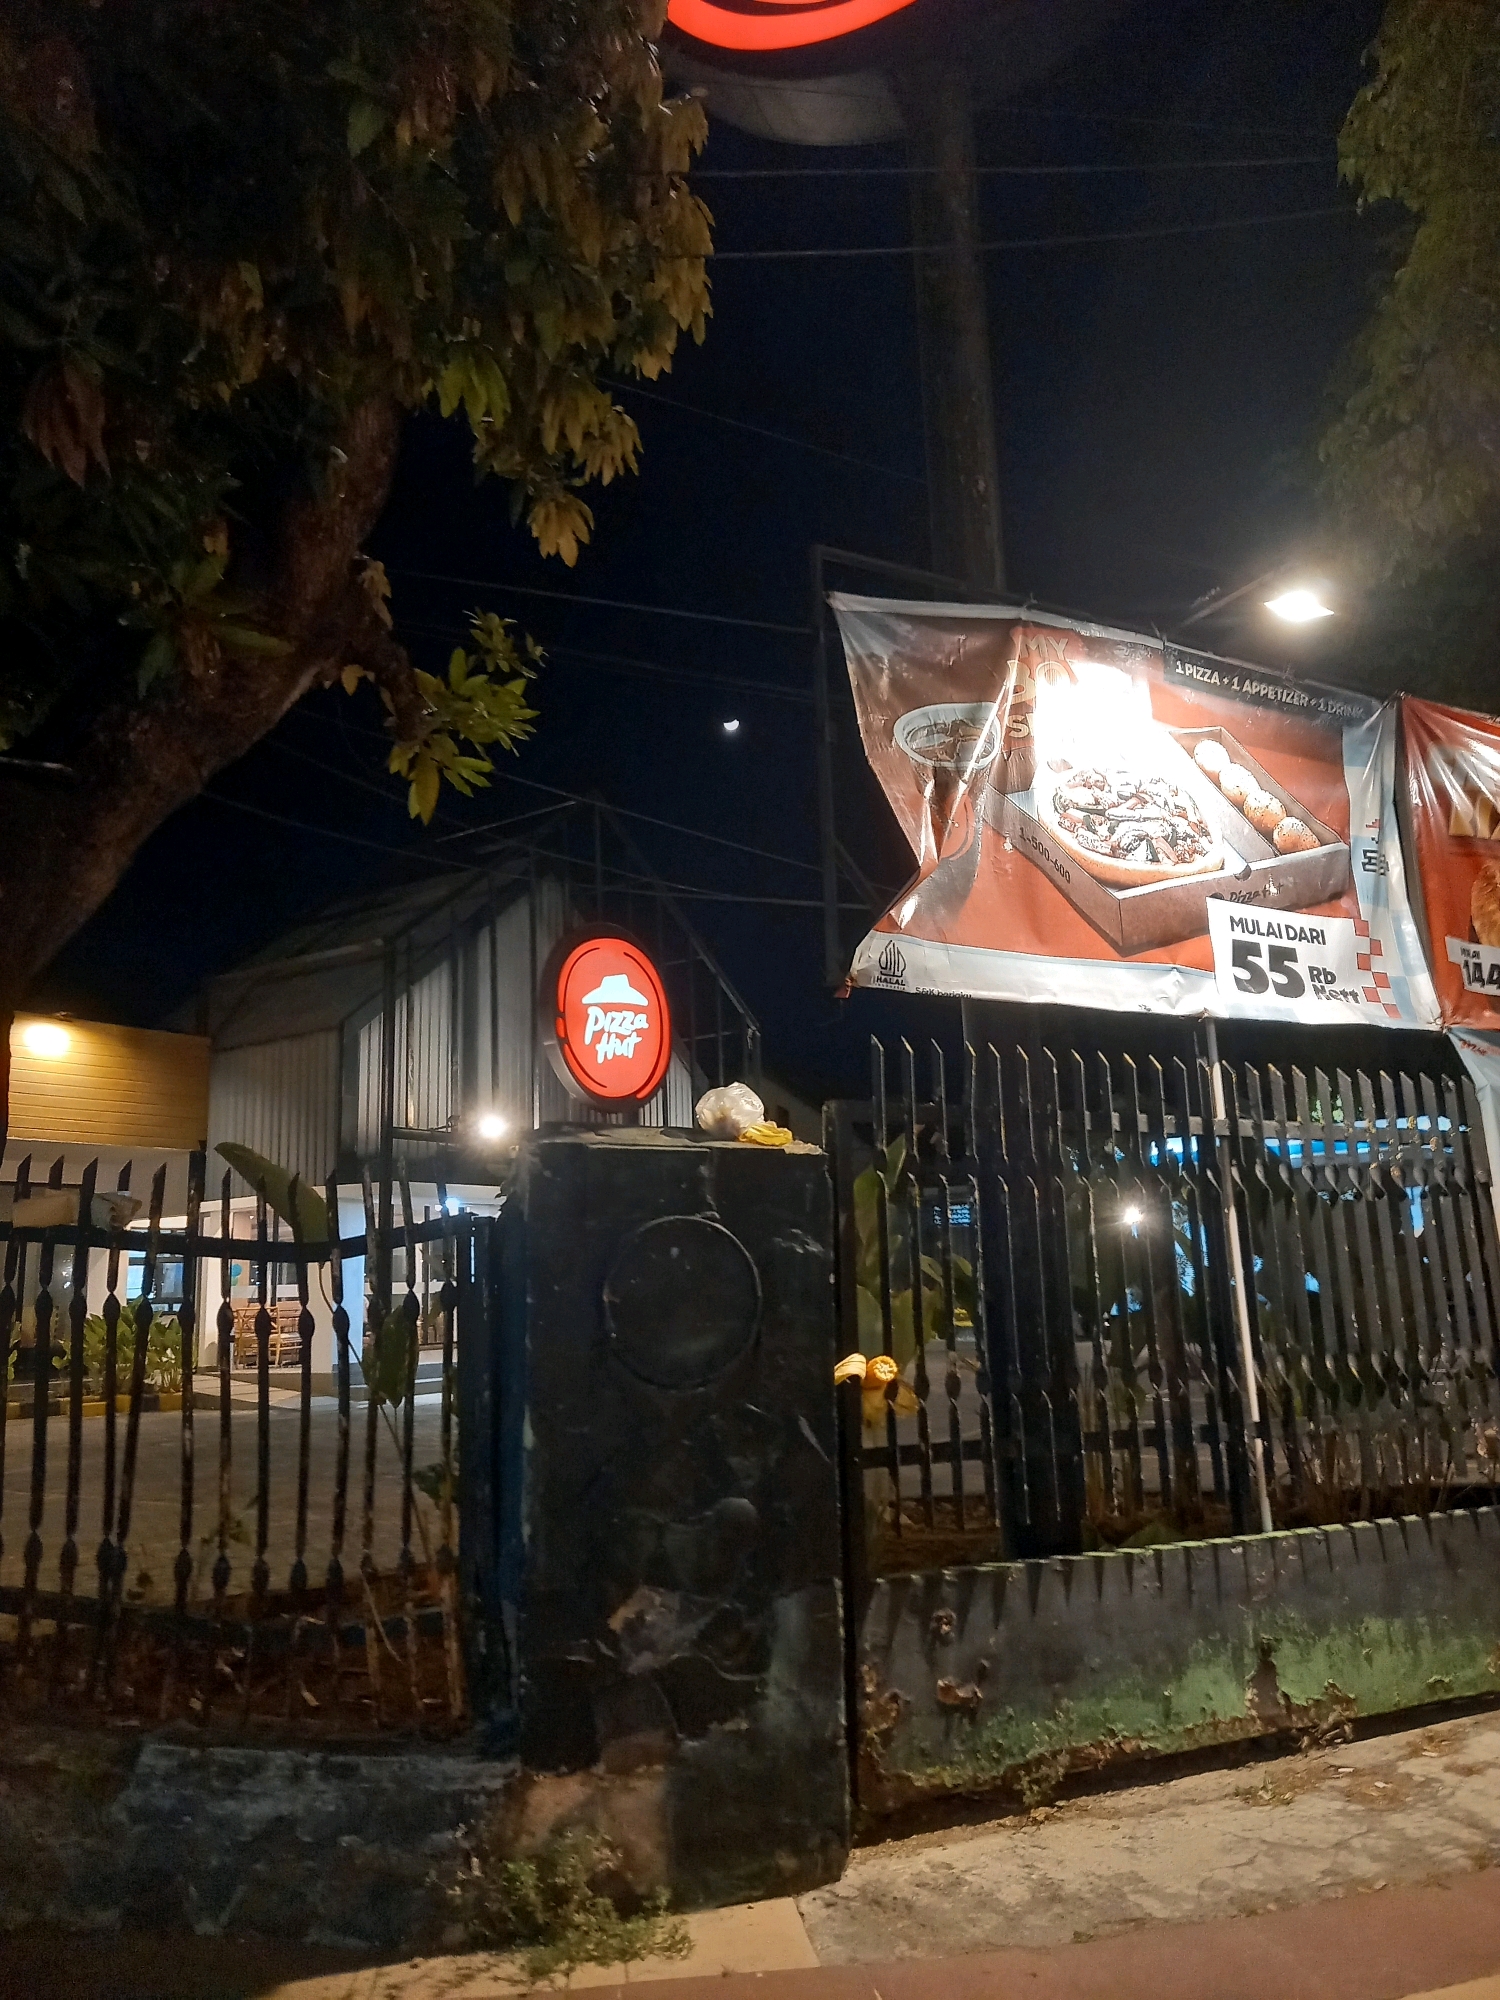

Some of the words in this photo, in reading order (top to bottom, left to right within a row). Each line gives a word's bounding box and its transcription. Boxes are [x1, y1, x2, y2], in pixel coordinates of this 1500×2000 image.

[1019, 634, 1069, 660] MY
[1175, 660, 1185, 675] 1
[1185, 663, 1221, 686] PIZZA
[1231, 677, 1241, 692] 1
[1242, 678, 1309, 708] APPETIZER
[1230, 915, 1283, 939] MULAI
[1285, 924, 1327, 946] DARI
[876, 975, 906, 986] HALAL
[1232, 939, 1306, 998] 55
[1308, 965, 1337, 985] Rb
[1312, 983, 1360, 1004] Nett
[584, 1006, 649, 1045] Pizza
[596, 1032, 642, 1064] Hut
